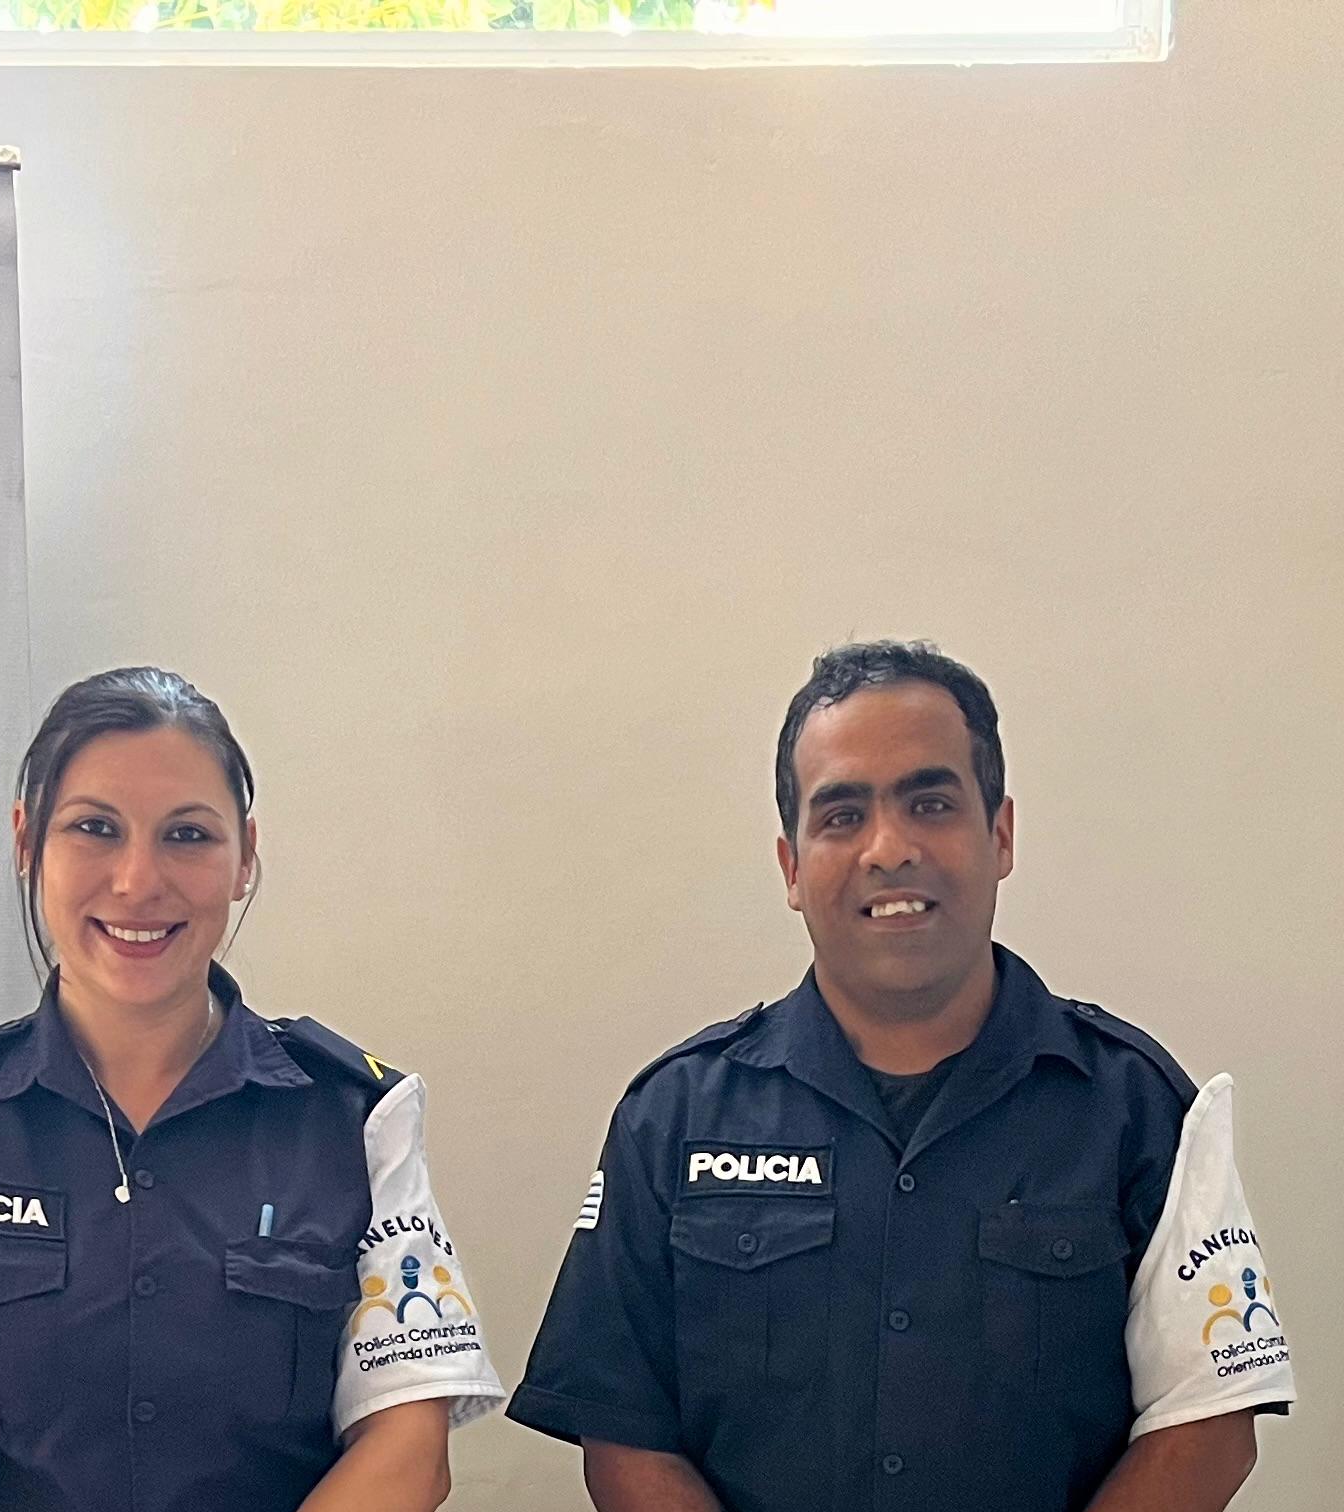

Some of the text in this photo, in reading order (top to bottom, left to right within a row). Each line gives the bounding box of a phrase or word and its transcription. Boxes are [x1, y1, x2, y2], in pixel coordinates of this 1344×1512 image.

[688, 1152, 823, 1186] POLICIA
[353, 1333, 406, 1357] Policía
[1210, 1340, 1255, 1363] Policía
[359, 1348, 423, 1372] Orientada
[424, 1349, 433, 1358] a
[1217, 1354, 1275, 1378] Orientada
